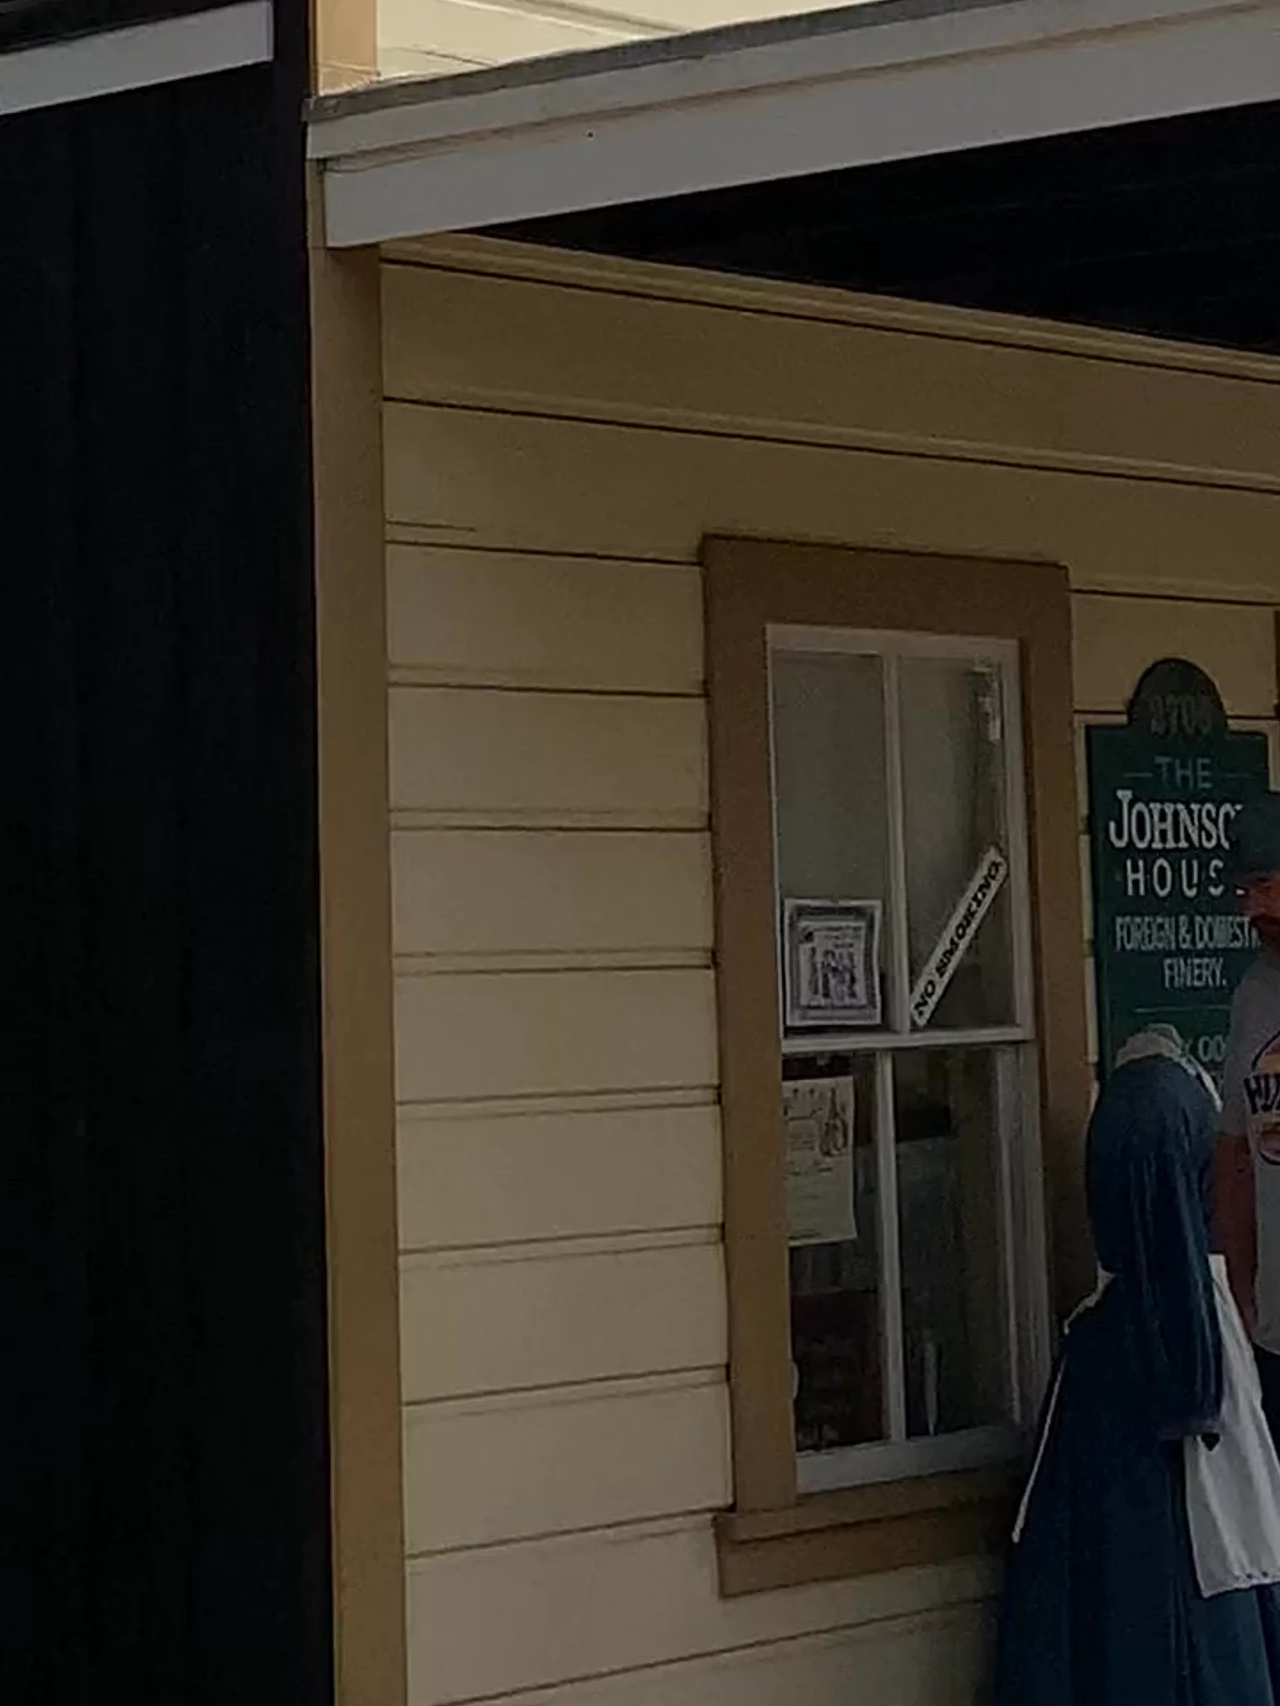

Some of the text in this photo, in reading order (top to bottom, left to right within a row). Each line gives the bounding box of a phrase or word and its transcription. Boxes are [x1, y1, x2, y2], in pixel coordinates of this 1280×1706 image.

[1154, 756, 1214, 791] THE
[1109, 789, 1244, 850] JOHNSO
[1126, 857, 1246, 897] HOUS
[914, 861, 1001, 1017] NO SMOKING
[1115, 915, 1176, 951] FOREIGN
[1178, 915, 1193, 950] &
